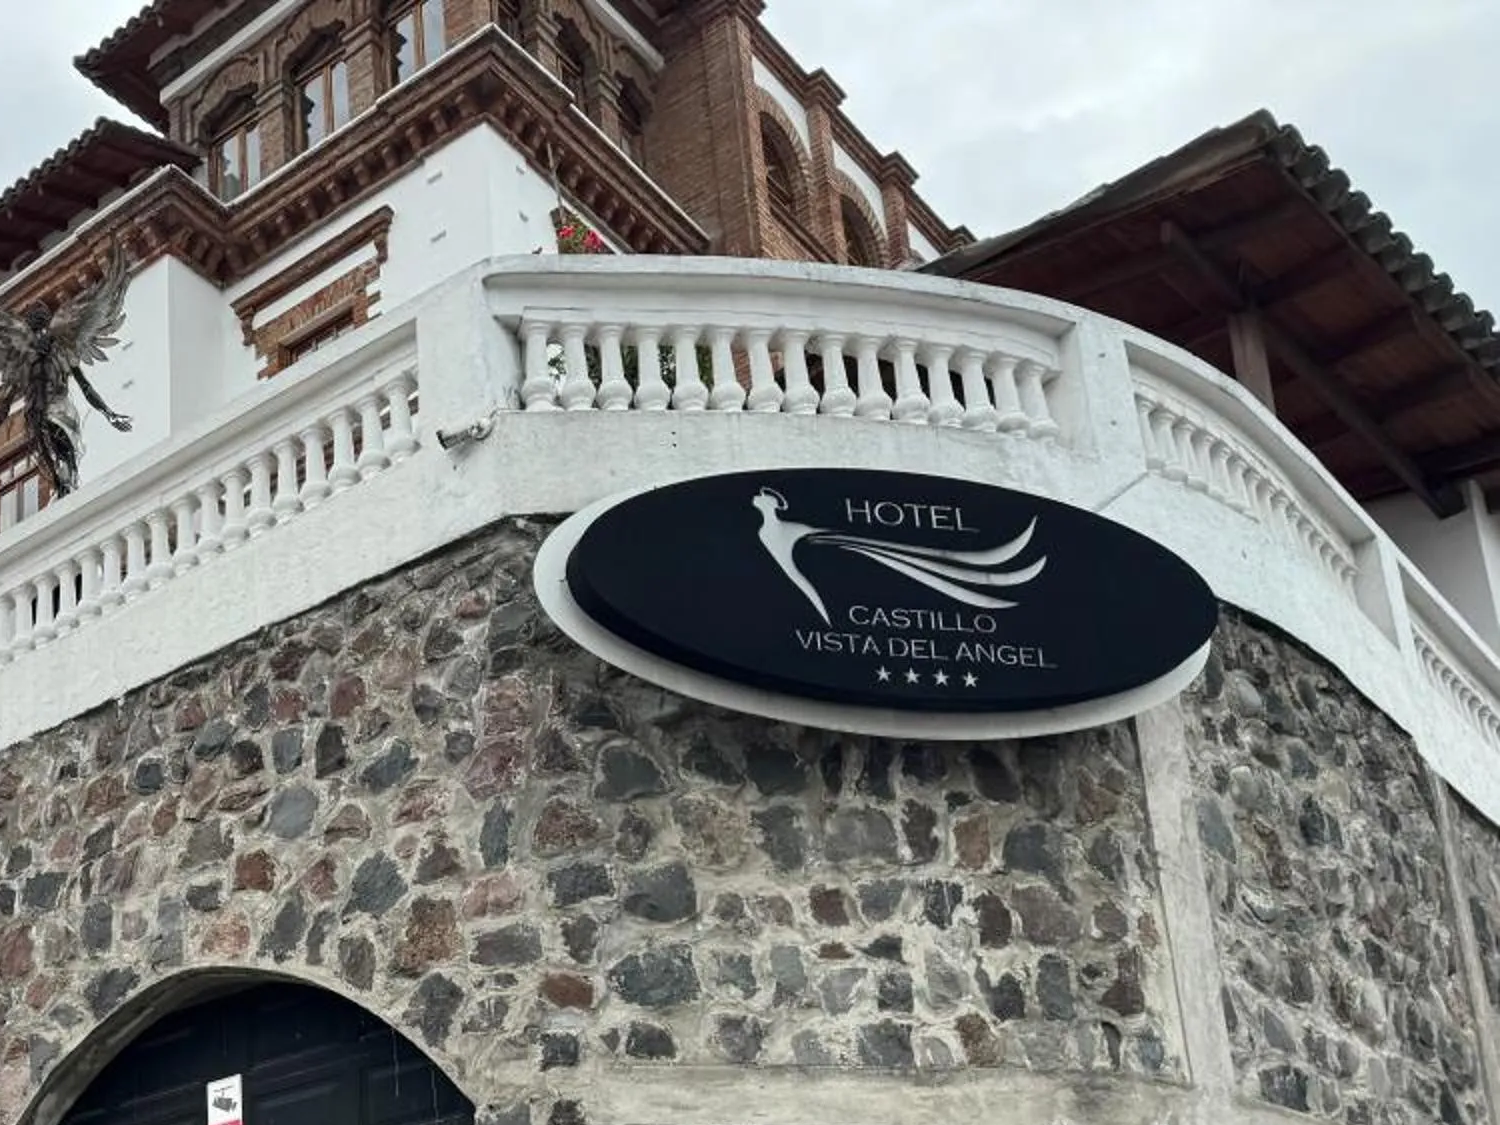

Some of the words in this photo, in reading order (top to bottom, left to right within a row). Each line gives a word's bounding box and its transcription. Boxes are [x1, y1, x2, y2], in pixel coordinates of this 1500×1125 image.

[845, 498, 980, 533] HOTEL
[849, 605, 997, 633] CASTILLO
[795, 629, 881, 655] VISTA
[889, 637, 950, 660] DEL
[955, 642, 1059, 669] ANGEL
